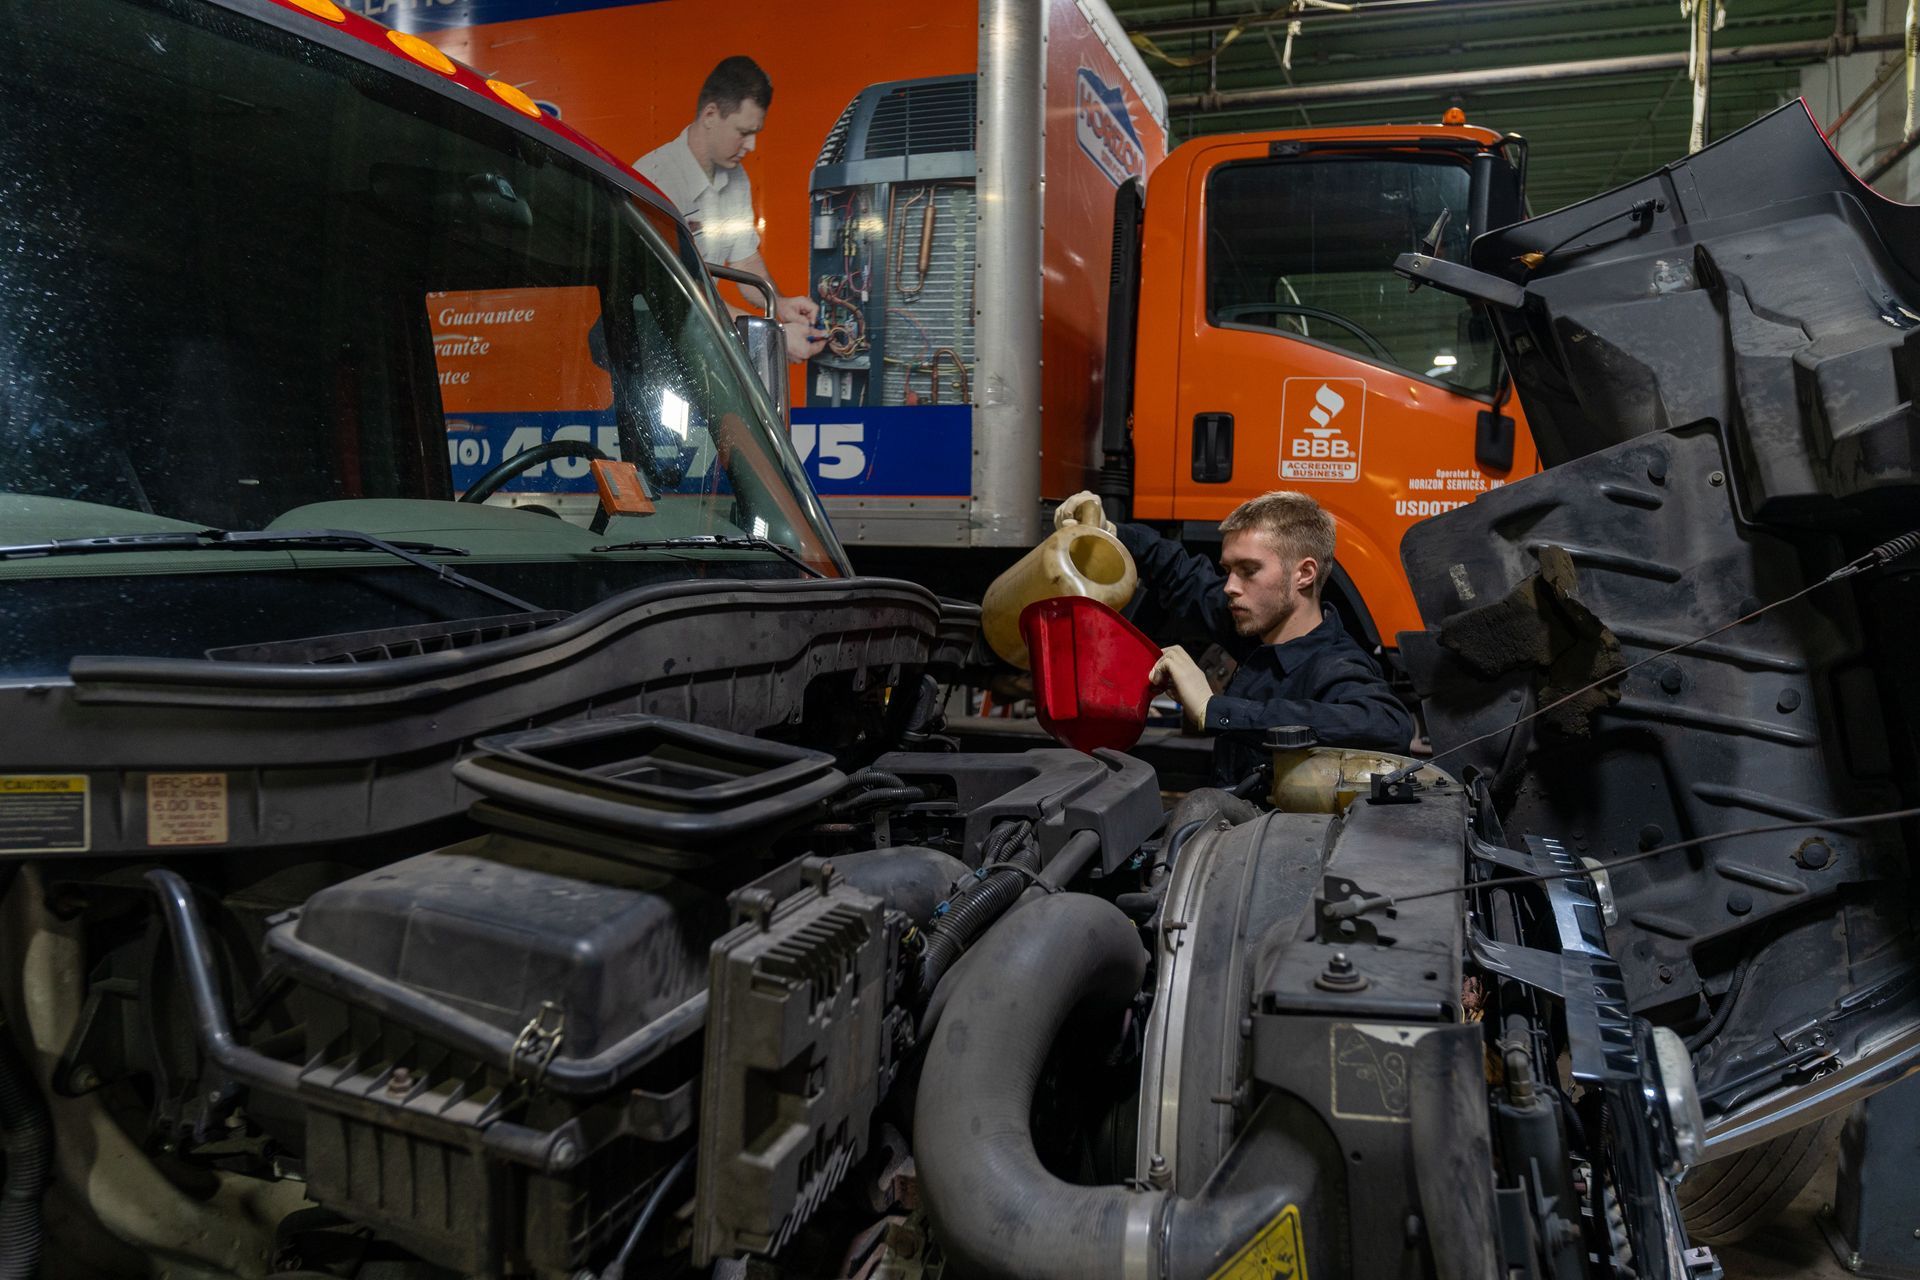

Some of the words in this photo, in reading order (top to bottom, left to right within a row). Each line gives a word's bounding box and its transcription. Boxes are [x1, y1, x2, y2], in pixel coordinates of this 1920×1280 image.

[438, 307, 535, 327] Guarantee
[433, 341, 490, 356] rantee
[446, 437, 489, 466] 10)
[1291, 438, 1348, 459] BBB
[1287, 462, 1352, 471] ACCREDITED
[1292, 469, 1345, 478] BUSINESS
[1436, 469, 1469, 479] Operated
[1471, 469, 1481, 480] by
[1408, 478, 1444, 491] HORIZON
[1446, 479, 1488, 492] SERVICES,
